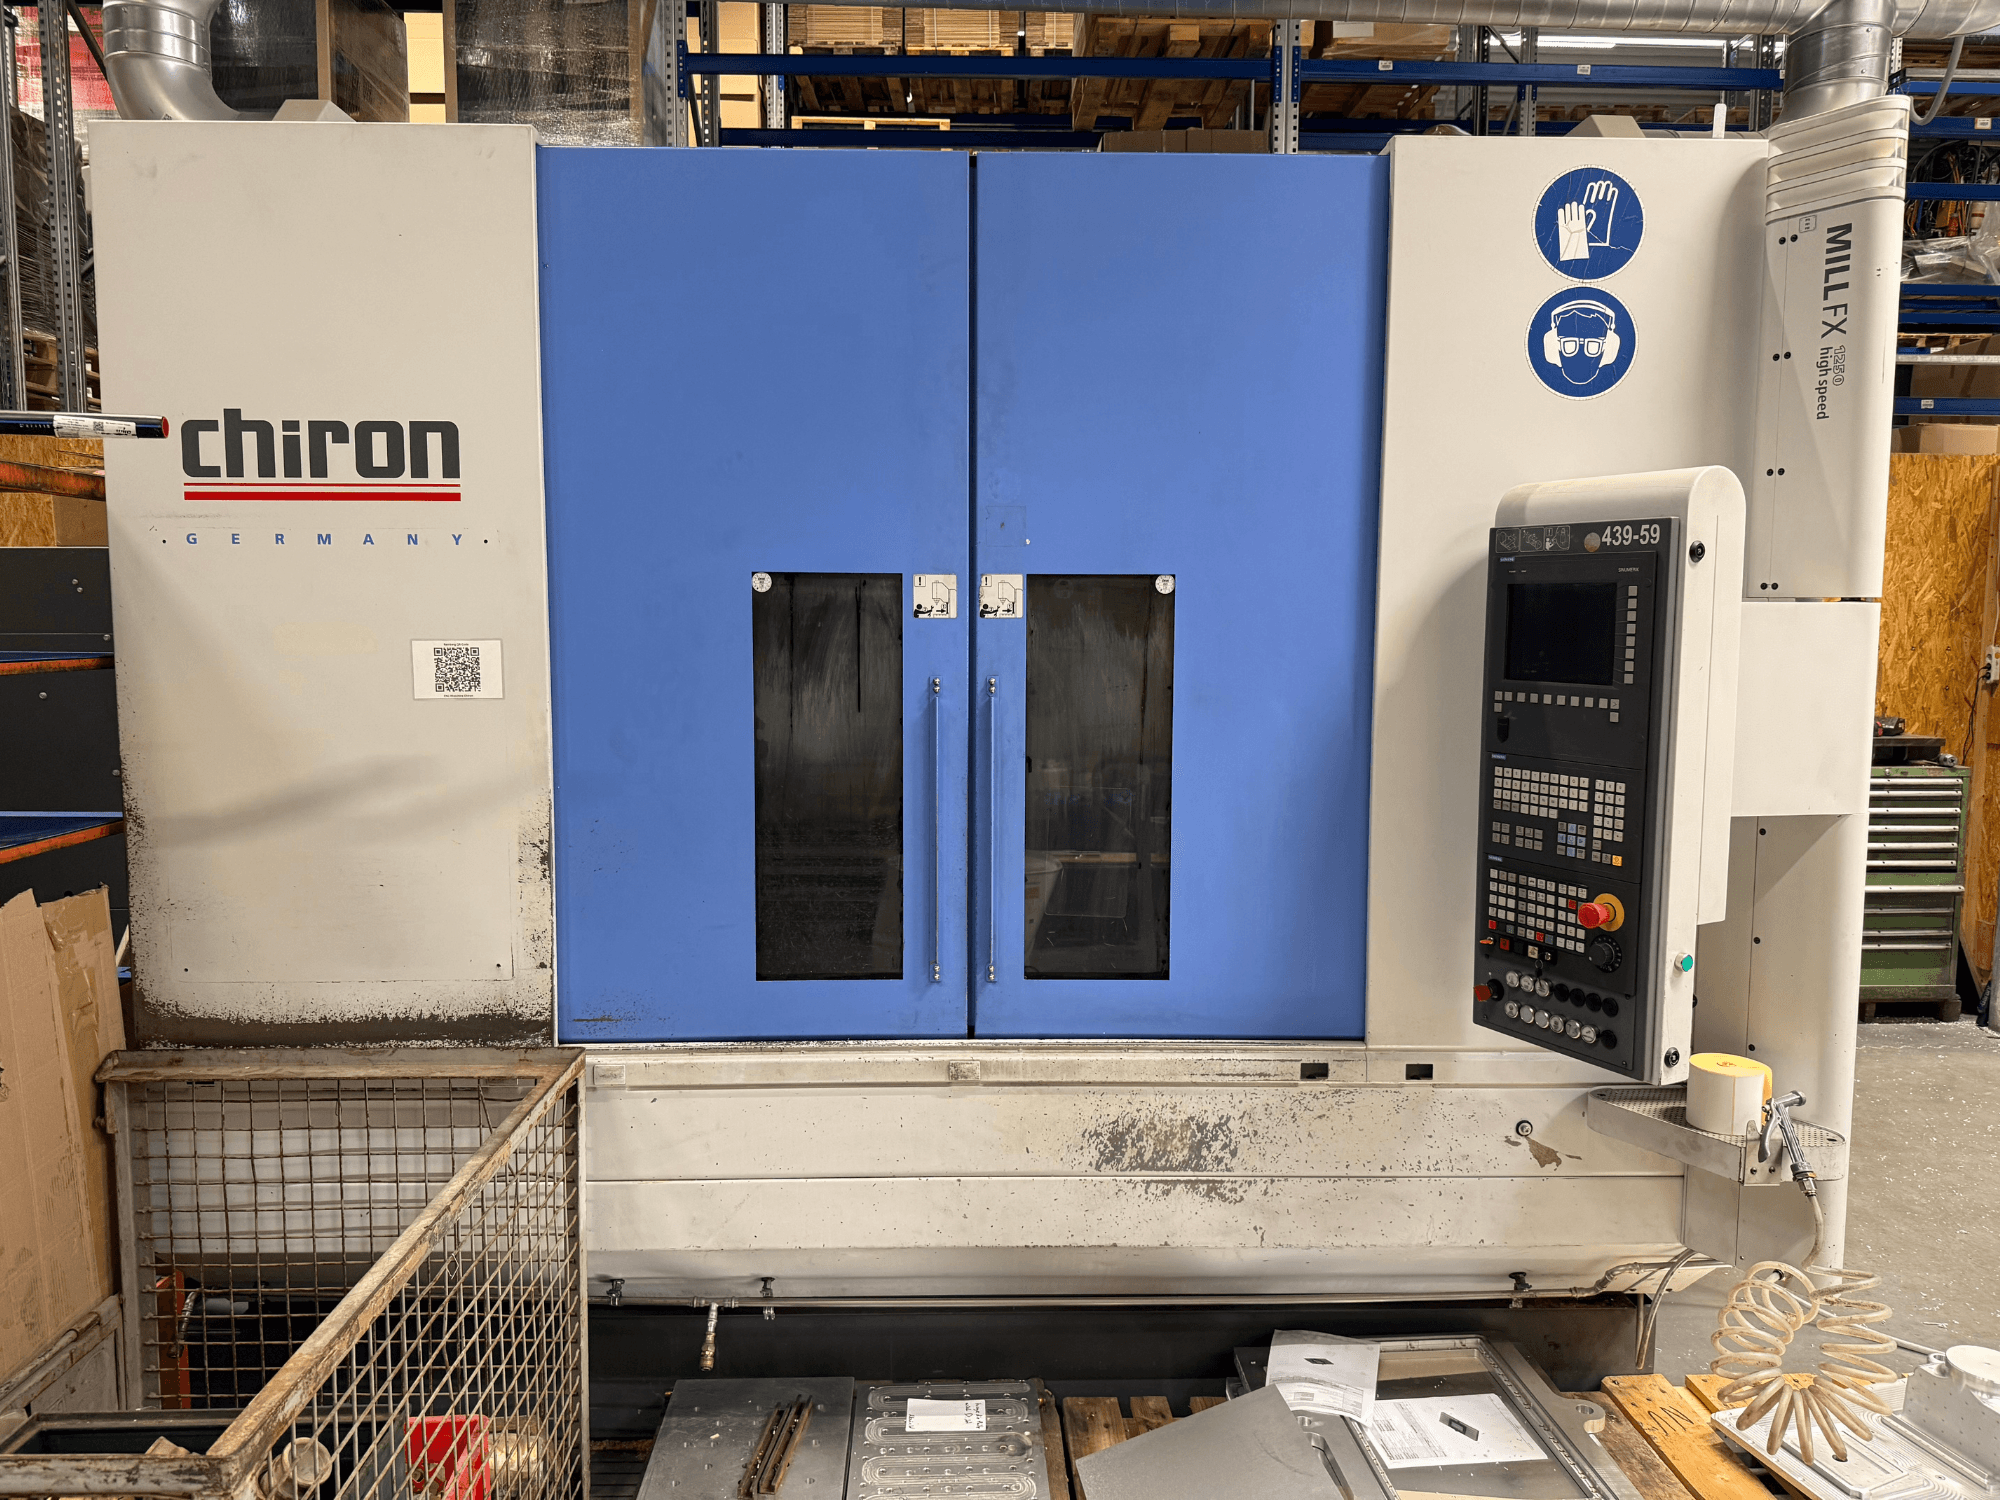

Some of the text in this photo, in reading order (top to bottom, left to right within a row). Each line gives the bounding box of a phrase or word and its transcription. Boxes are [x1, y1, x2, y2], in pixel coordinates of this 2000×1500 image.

[1821, 222, 1852, 339] MILL FX
[1815, 346, 1833, 420] high speed
[1832, 345, 1846, 386] 1250
[181, 408, 461, 479] chiron
[186, 533, 463, 546] GERMANY
[1601, 523, 1660, 546] 439-59
